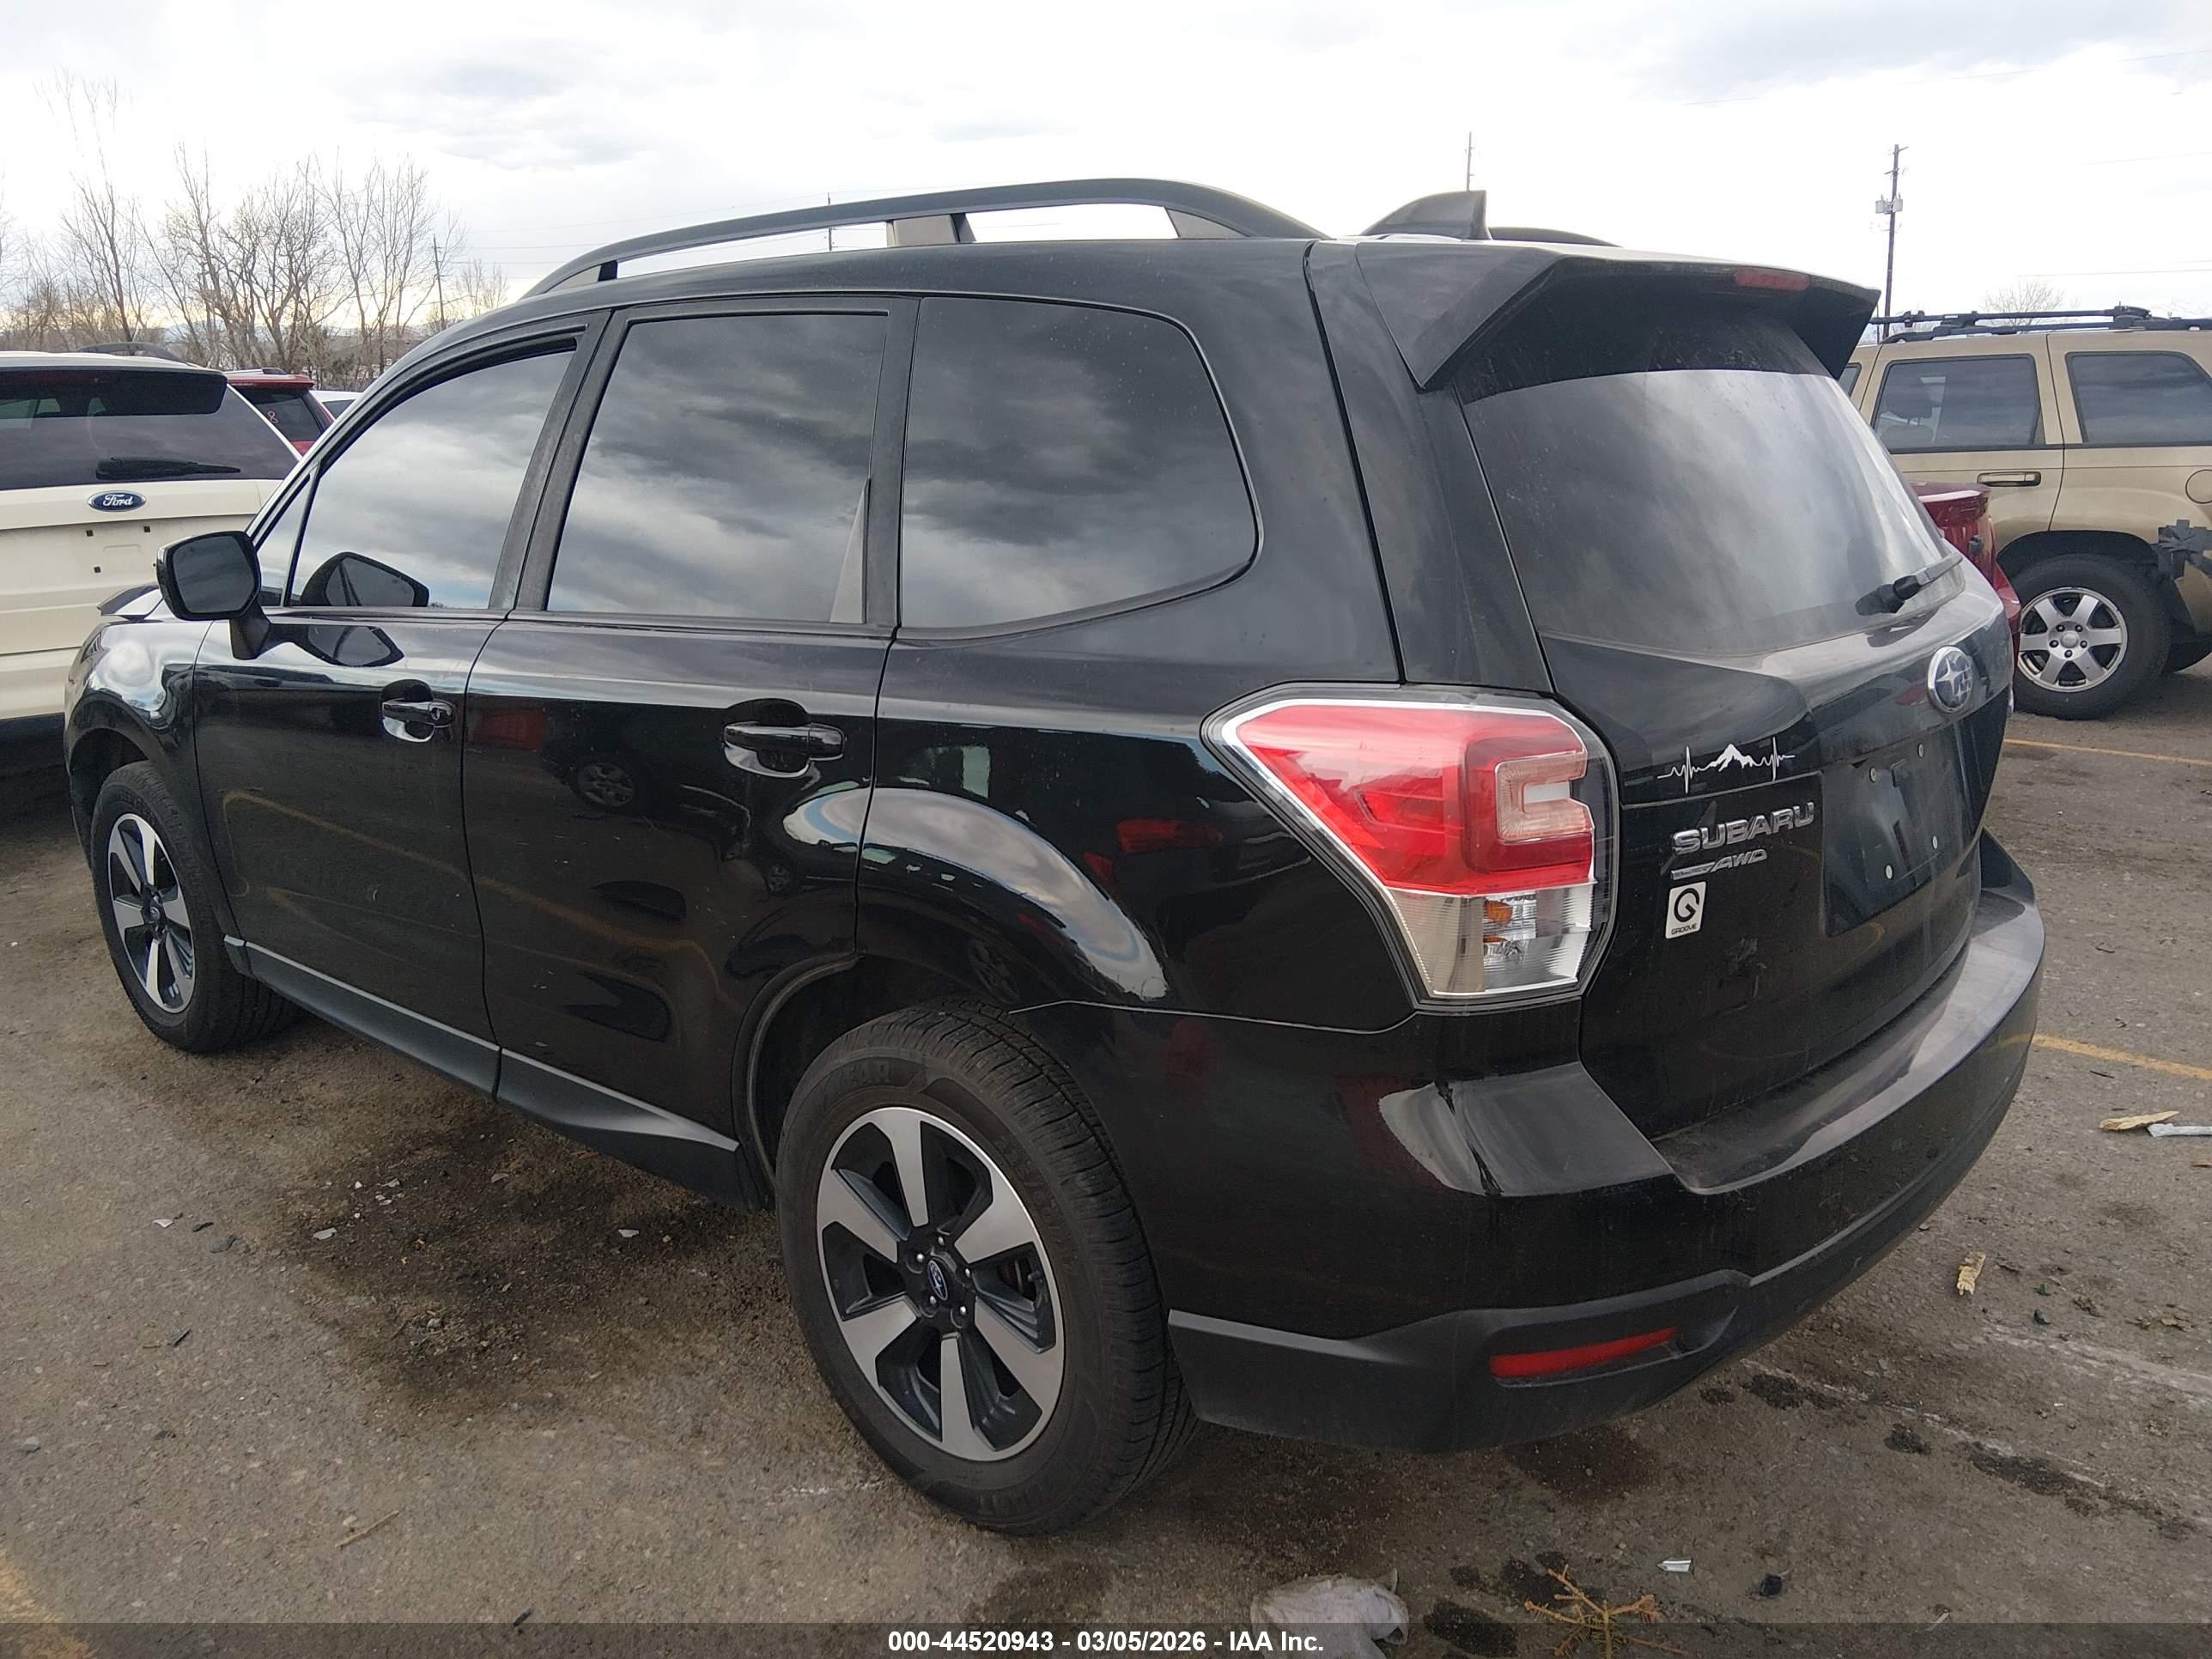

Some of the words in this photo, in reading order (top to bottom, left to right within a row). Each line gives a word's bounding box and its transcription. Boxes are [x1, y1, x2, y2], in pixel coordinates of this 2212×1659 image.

[102, 494, 134, 507] Ford
[1673, 802, 1814, 855] SUBARU
[1710, 848, 1768, 873] AWD
[1674, 888, 1700, 923] G
[1671, 922, 1698, 936] GROOVE
